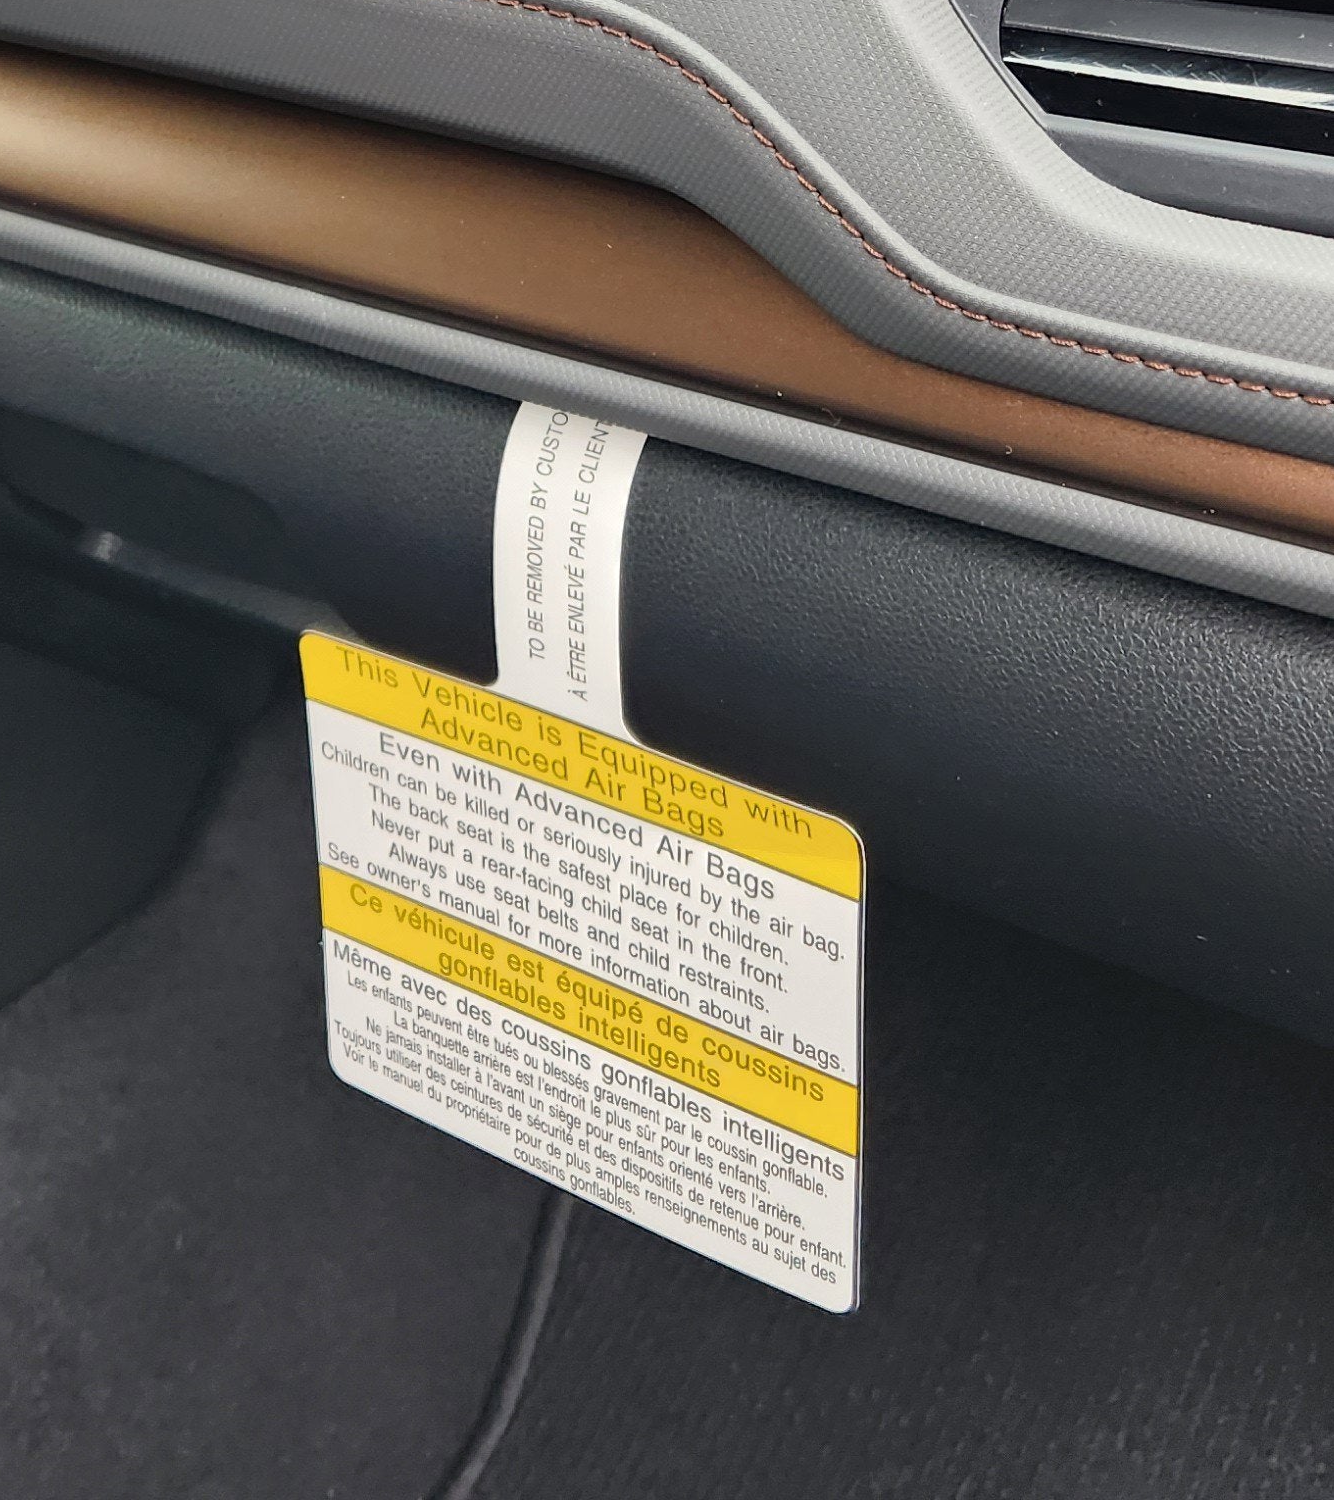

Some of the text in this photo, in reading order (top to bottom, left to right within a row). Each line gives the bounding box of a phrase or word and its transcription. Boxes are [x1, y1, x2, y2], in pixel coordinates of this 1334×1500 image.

[526, 515, 544, 604] REMOVED
[530, 481, 548, 510] BY
[568, 521, 587, 559] PAR
[572, 489, 591, 515] LE
[527, 608, 544, 633] BE
[528, 637, 545, 659] TO
[564, 563, 585, 634] ENLEVÉ
[566, 637, 587, 683] ÊTRE
[335, 645, 813, 840] This Vehicle is Equipped with
[379, 731, 775, 900] Even with Advanced Air Bags
[420, 706, 725, 838] Advanced Air Bags
[321, 740, 845, 963] Children can be killed or seriously injured by the air bag.
[368, 781, 789, 967] The back seat is the safest place for children.
[371, 808, 788, 994] Never put a rear-facing child seat in the front.
[388, 841, 770, 1014] Always use seat belts and child restraints.
[327, 841, 846, 1073] See owner's manual for more information about air bags.
[349, 883, 824, 1102] Ce véhicule est équipé de coussins
[438, 951, 721, 1089] gonflables intelligents
[333, 938, 845, 1182] Même avec des coussins gonflables intelligents
[333, 1019, 847, 1269] Toujours utiliser des ceintures de sécurité et des dispositifs de retenue pour enfant.
[347, 969, 828, 1199] Les enfants peuvent être tués ou blessés gravement par le coussin gonflable.
[365, 1015, 805, 1231] Ne jamais installer à l'avant un siège pour enfants orienté vers l'arrière.
[393, 1009, 771, 1195] La banquette arrière est l'endroit le plus sûr pour les enfants.
[342, 1041, 837, 1285] Voir le manuel du propriétaire pour de plus amples renseignements au sujet des
[513, 1147, 636, 1216] coussins gonflables.
